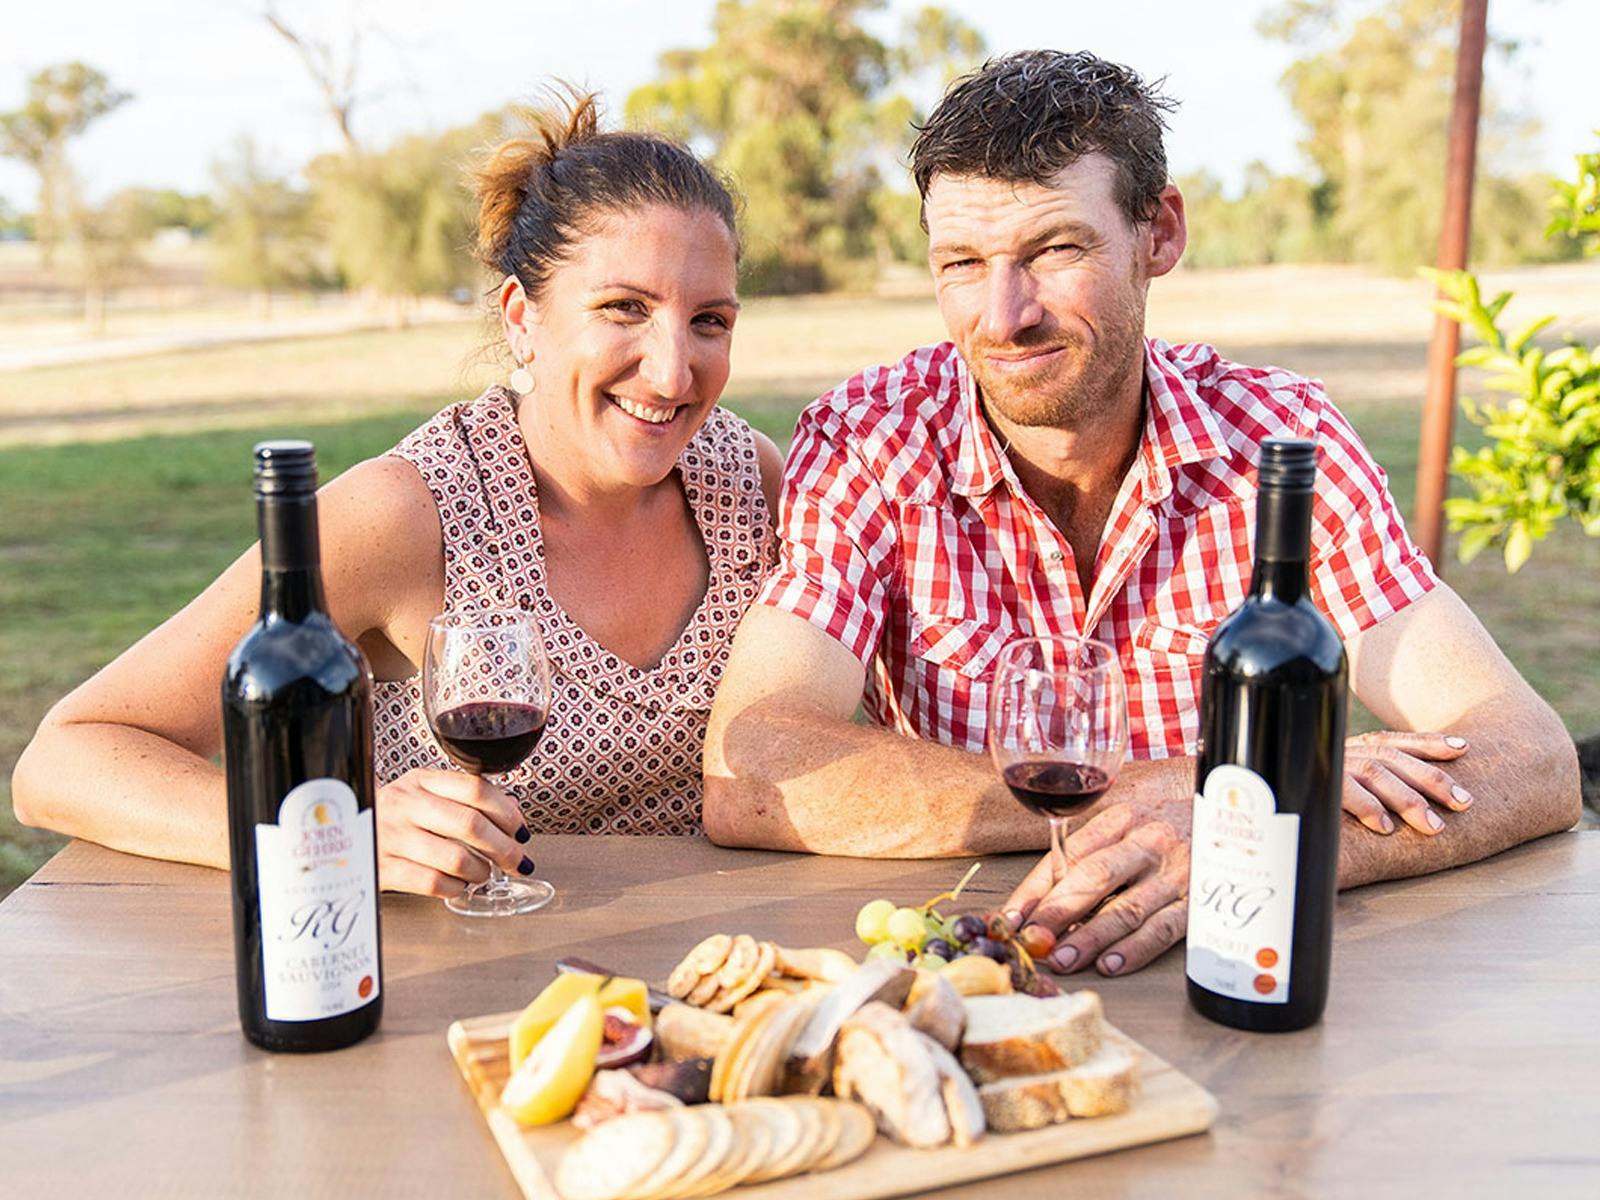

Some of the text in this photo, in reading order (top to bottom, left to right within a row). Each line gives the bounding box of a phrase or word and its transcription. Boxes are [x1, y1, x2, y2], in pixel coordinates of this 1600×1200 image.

[301, 825, 343, 842] JOHN
[277, 956, 372, 984] SAUVIGNON
[285, 943, 368, 970] CABERNET
